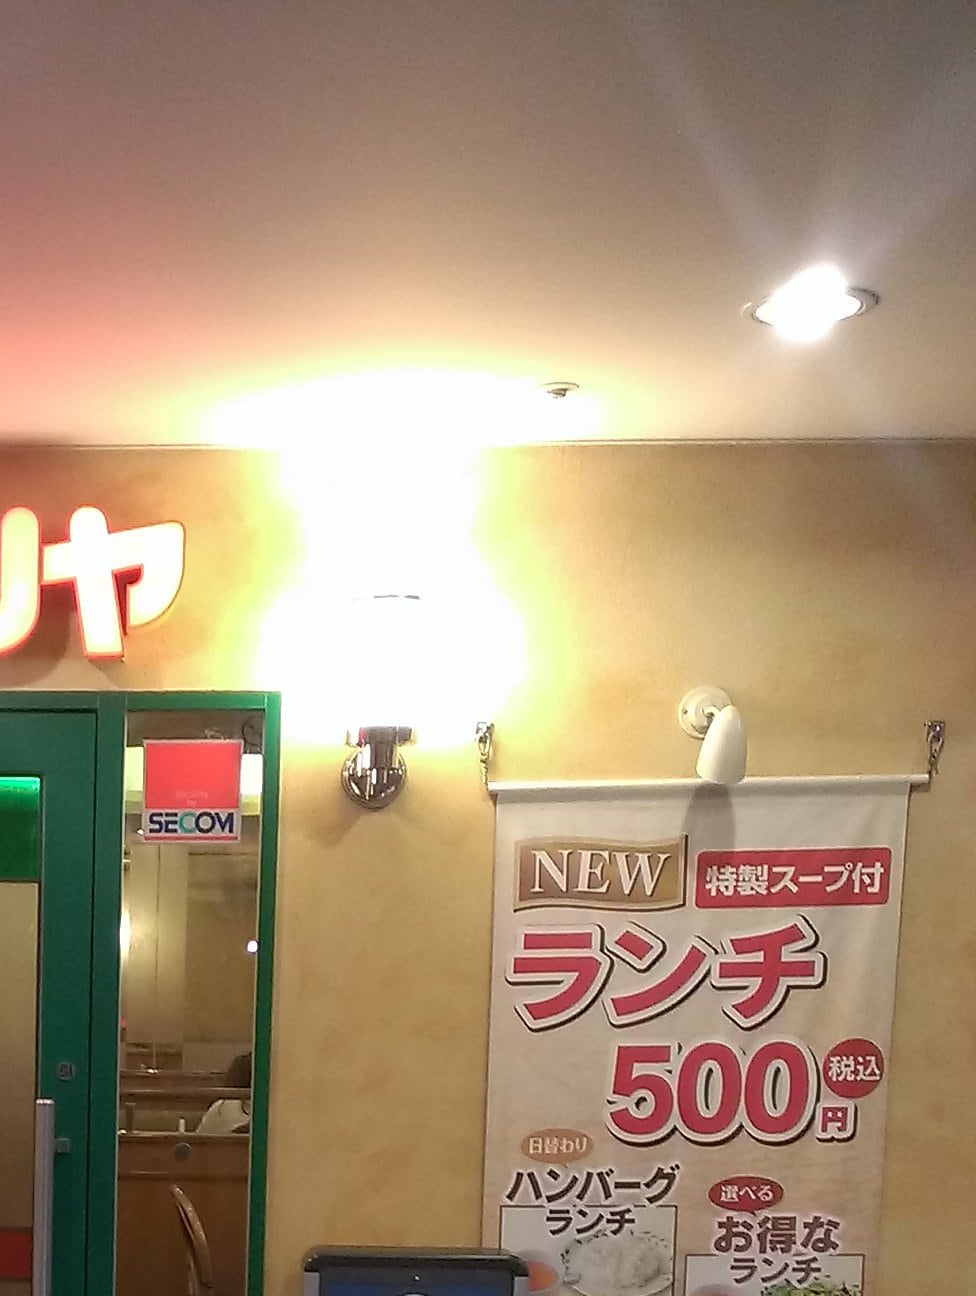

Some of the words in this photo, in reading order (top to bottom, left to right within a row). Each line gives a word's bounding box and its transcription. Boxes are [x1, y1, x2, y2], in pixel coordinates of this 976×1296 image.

[148, 811, 234, 834] SECOM
[530, 849, 671, 897] NEW
[705, 862, 885, 897] 特製スープ付
[511, 921, 818, 1022] ランチ
[828, 1055, 881, 1082] 税込
[527, 1135, 590, 1155] 日替わり
[504, 1164, 681, 1204] ハンバーグ
[719, 1183, 774, 1202] 選べる
[545, 1207, 636, 1237] ランチ
[713, 1215, 841, 1254] お得な
[728, 1255, 823, 1286] ランチ
